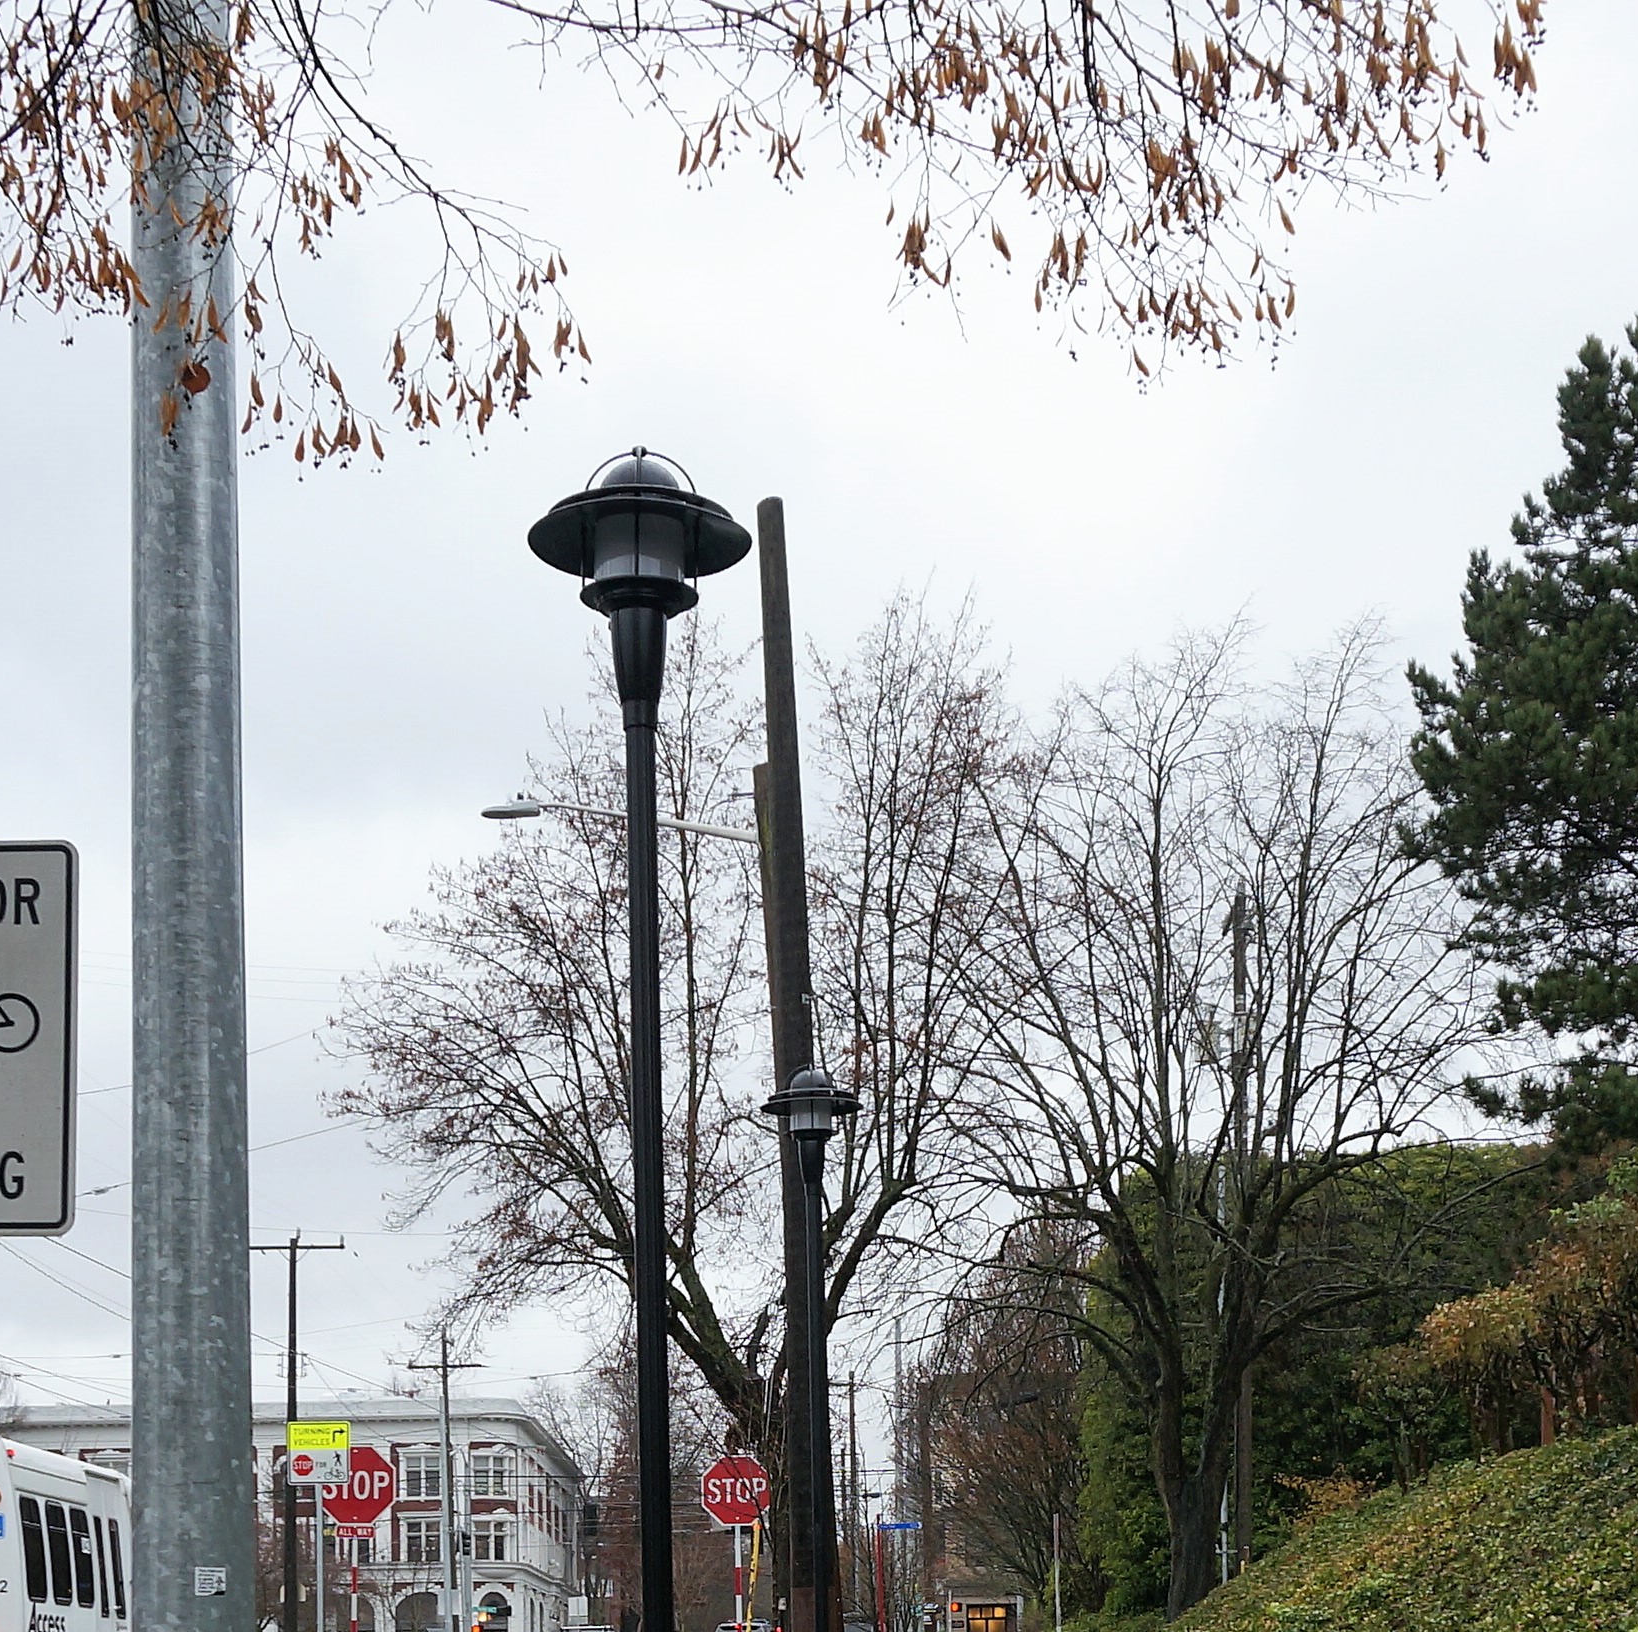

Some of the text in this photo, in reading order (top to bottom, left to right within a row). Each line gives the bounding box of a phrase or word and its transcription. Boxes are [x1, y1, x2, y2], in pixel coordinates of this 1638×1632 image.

[293, 1428, 331, 1436] TURNING
[293, 1438, 331, 1446] VEHICLES
[293, 1460, 313, 1470] STOP
[707, 1477, 767, 1504] STOP
[338, 1528, 353, 1536] ALL
[356, 1528, 372, 1536] WAY
